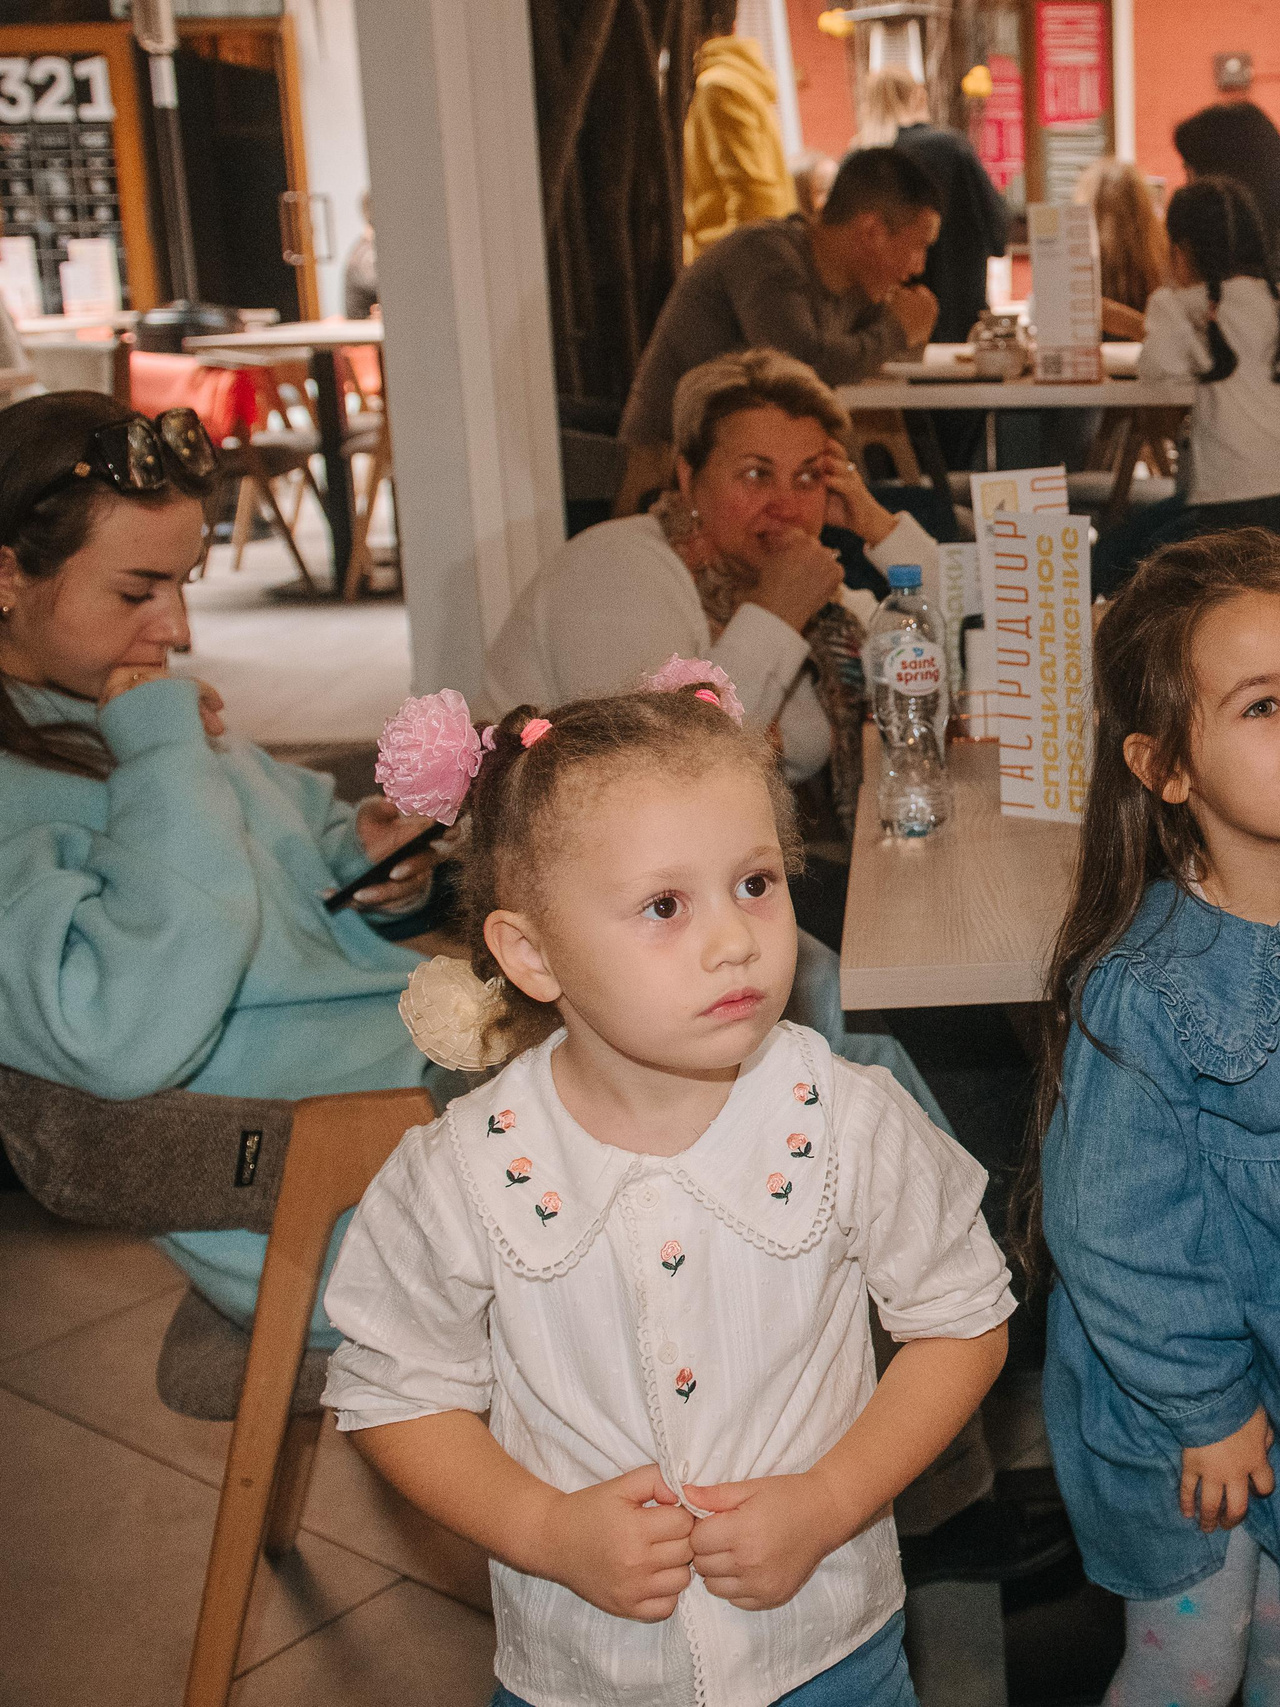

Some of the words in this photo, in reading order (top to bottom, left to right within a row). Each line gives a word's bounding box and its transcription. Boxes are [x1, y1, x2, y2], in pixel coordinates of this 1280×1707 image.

[0, 56, 117, 123] 321
[901, 656, 935, 670] saint
[896, 668, 940, 687] spring
